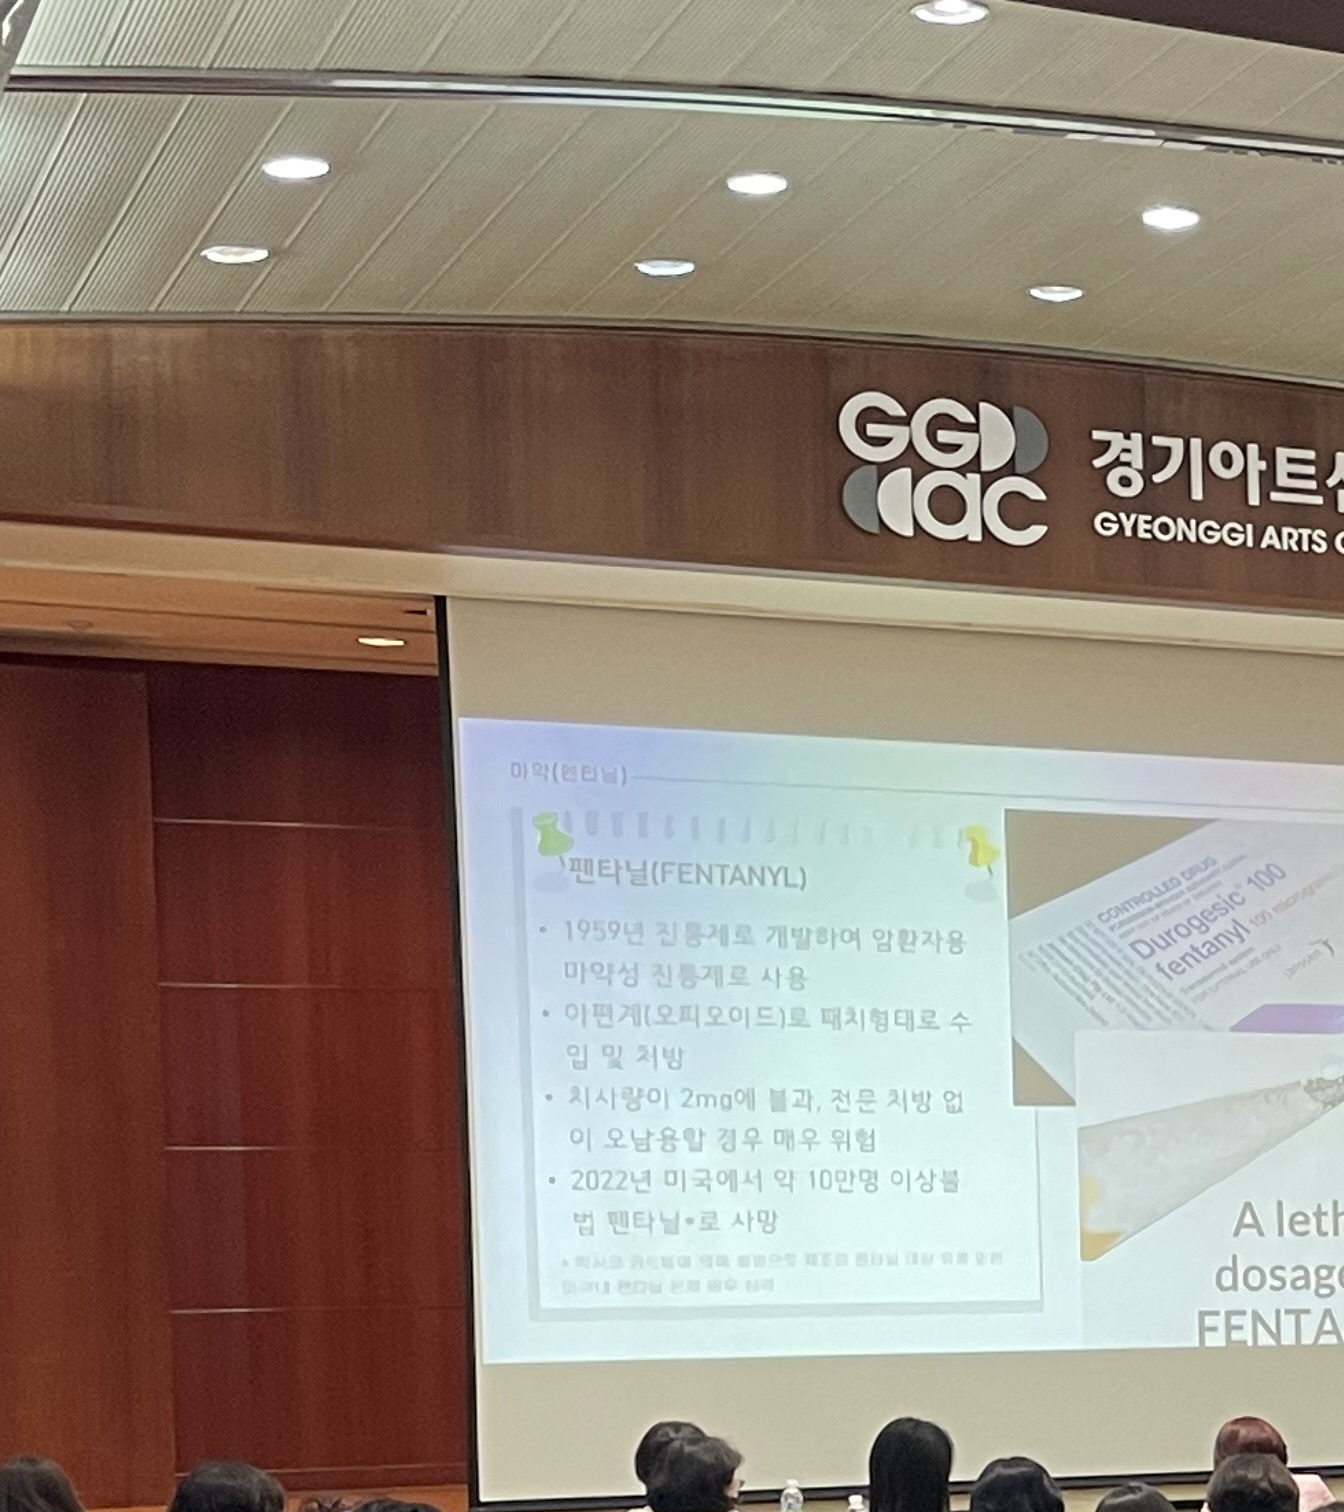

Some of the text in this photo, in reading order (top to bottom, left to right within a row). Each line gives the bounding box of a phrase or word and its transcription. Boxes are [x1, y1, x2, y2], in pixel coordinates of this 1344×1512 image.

[1093, 511, 1254, 549] GYEONGGI
[1260, 525, 1328, 555] ARTS
[568, 856, 808, 892] 펜타닐(FENTANYL)
[1246, 862, 1287, 892] 100
[564, 919, 968, 956] 1959년 진통제로 개발하여 암환자용
[1156, 919, 1251, 982] fentanyl
[563, 960, 811, 992] 마약성 진통제로 사용
[821, 1007, 941, 1033] 패치형태로
[949, 1009, 973, 1034] 수
[566, 1042, 686, 1071] 입 및 처방
[567, 1086, 670, 1111] 치사량이
[680, 1087, 757, 1113] 2mg에
[829, 1087, 880, 1114] 전문
[885, 1087, 933, 1114] 처방
[942, 1087, 965, 1115] 없
[568, 1127, 878, 1154] 이 오남용할 경우 매우 위험
[570, 1168, 653, 1194] 2022년
[663, 1168, 764, 1194] 미국에서
[773, 1168, 796, 1194] 약
[808, 1168, 880, 1194] 10만명
[573, 1209, 596, 1237] 법
[729, 1209, 780, 1235] 사망
[1232, 1200, 1266, 1238] A
